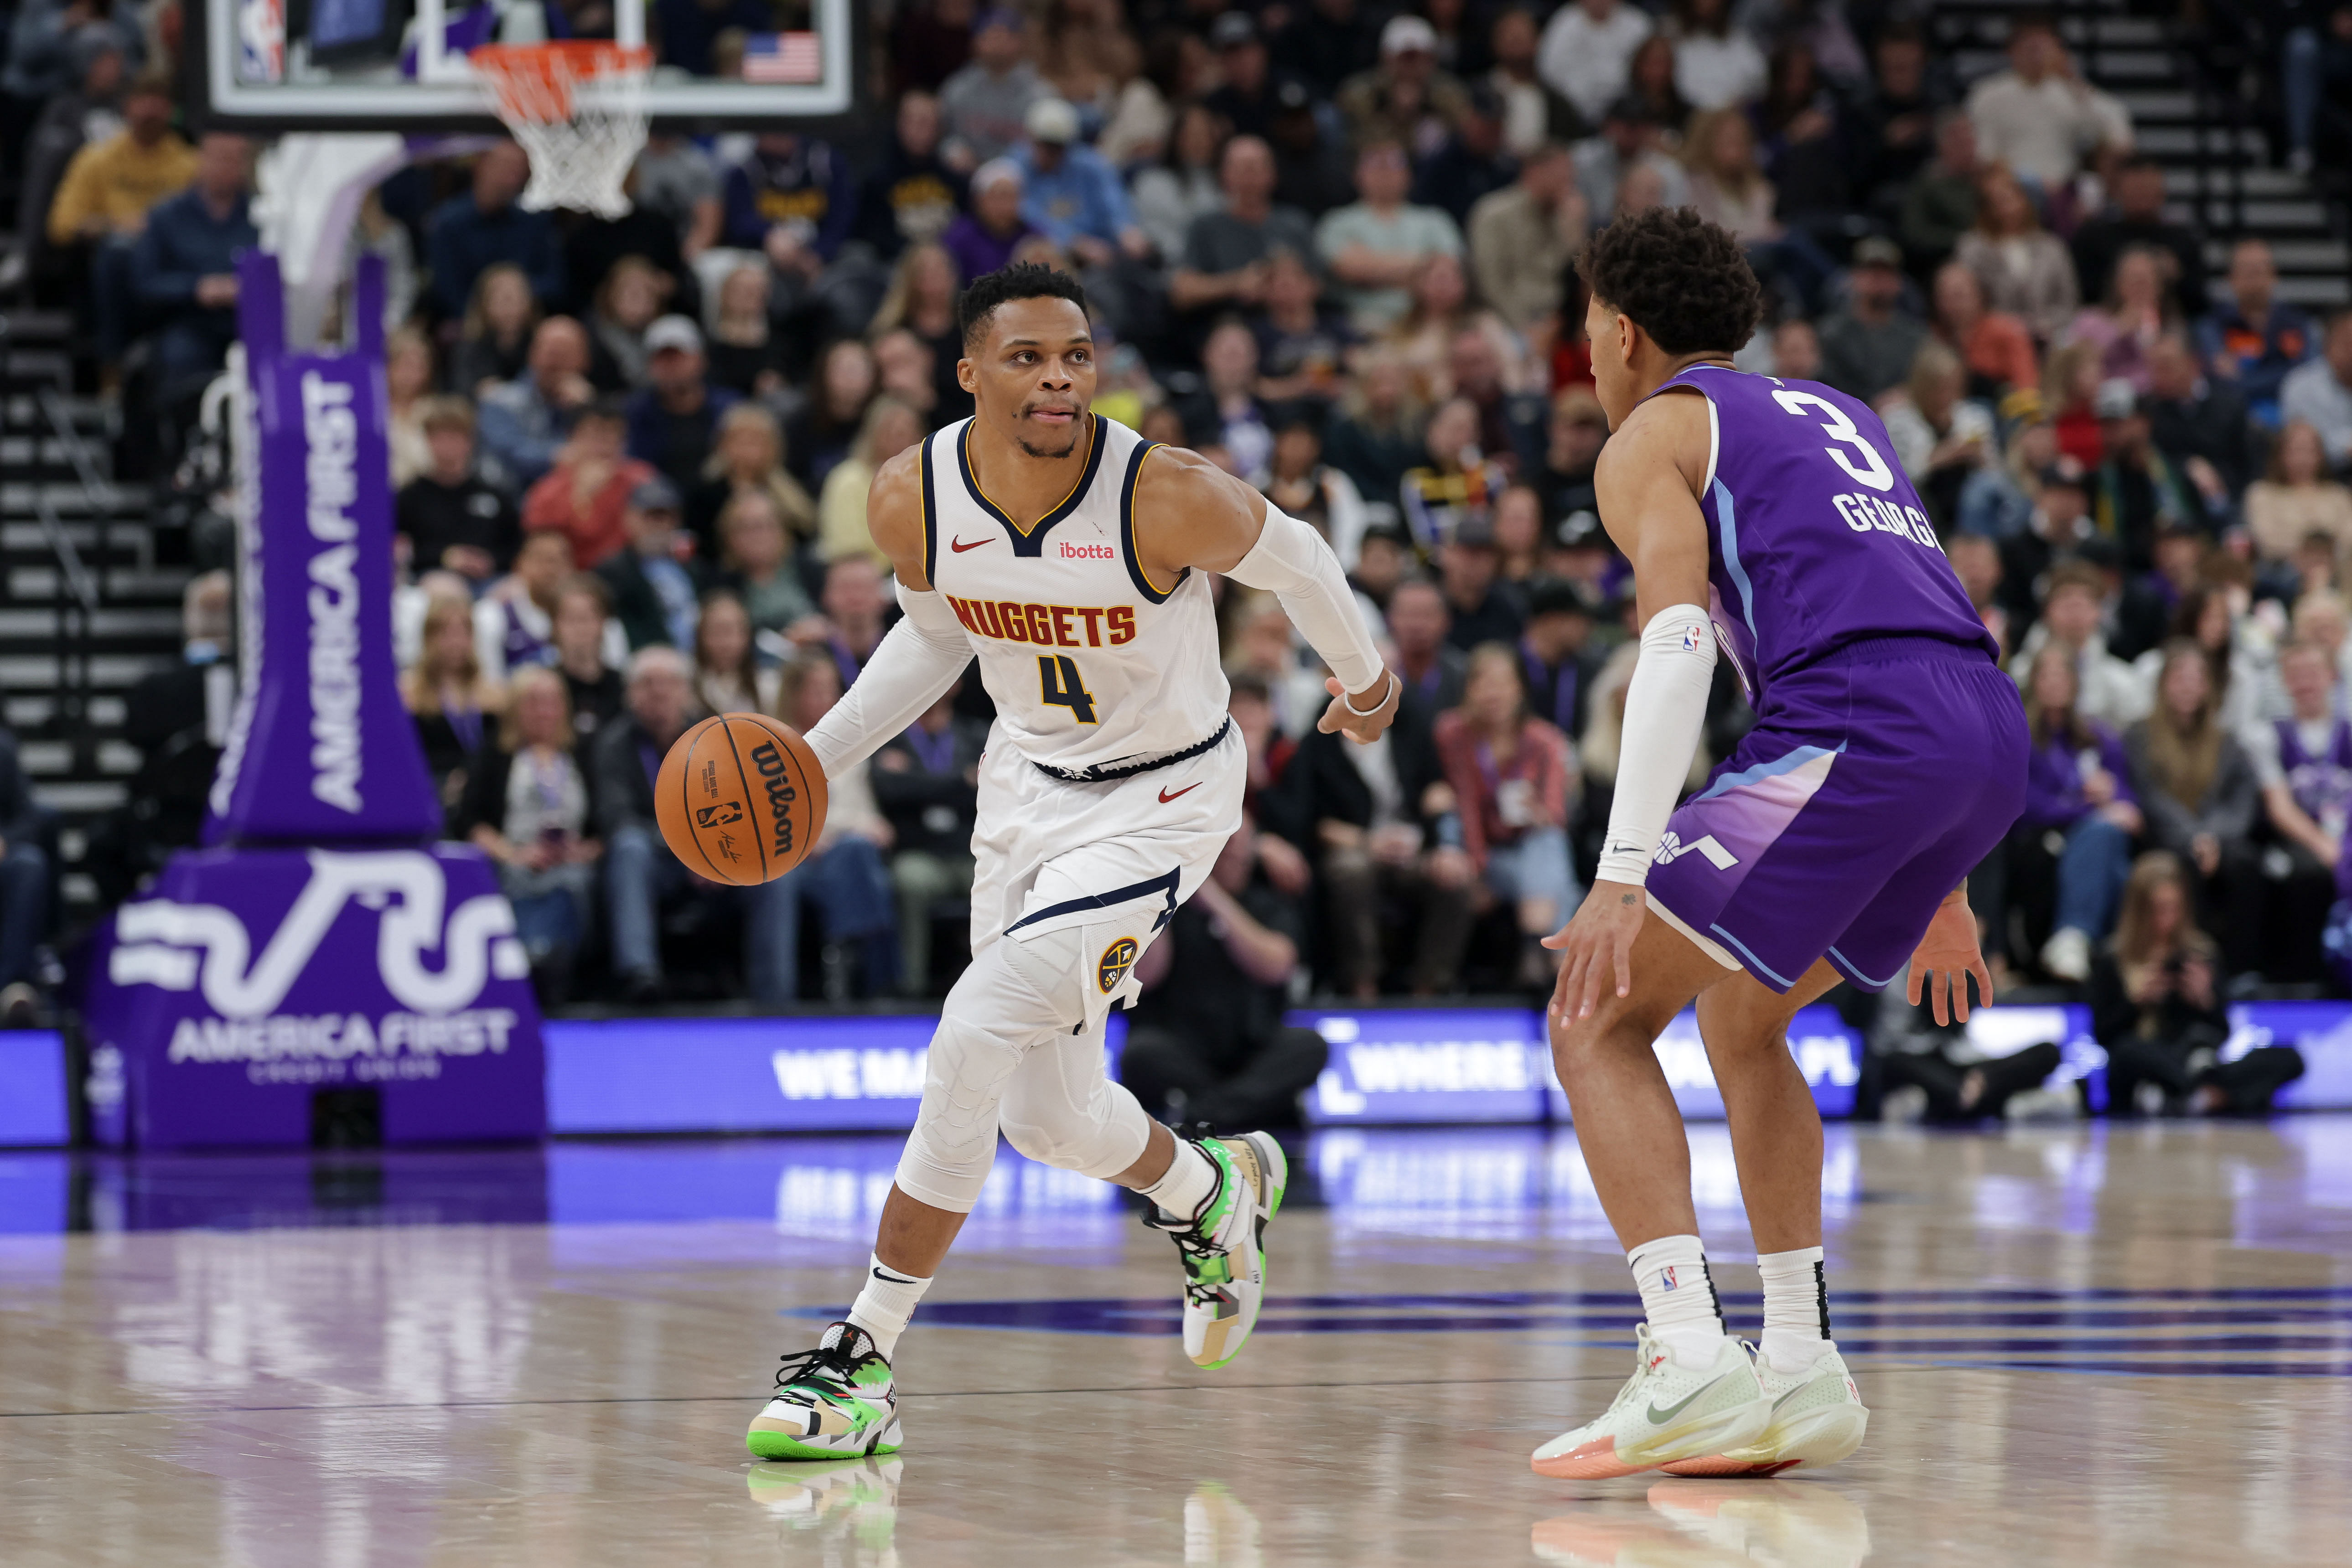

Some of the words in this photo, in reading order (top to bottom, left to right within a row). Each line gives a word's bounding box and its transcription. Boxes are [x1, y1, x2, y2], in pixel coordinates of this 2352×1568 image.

[301, 371, 359, 542] FIRST
[1771, 390, 1895, 492] 3
[1059, 542, 1114, 559] ibotta
[945, 594, 1137, 648] NUGGETS
[307, 543, 364, 815] AMERICA
[1036, 653, 1099, 725] 4
[751, 740, 796, 858] Wilson
[168, 1012, 378, 1063] AMERICA
[379, 1008, 519, 1057] FIRST
[1347, 1042, 1527, 1092] WHERE
